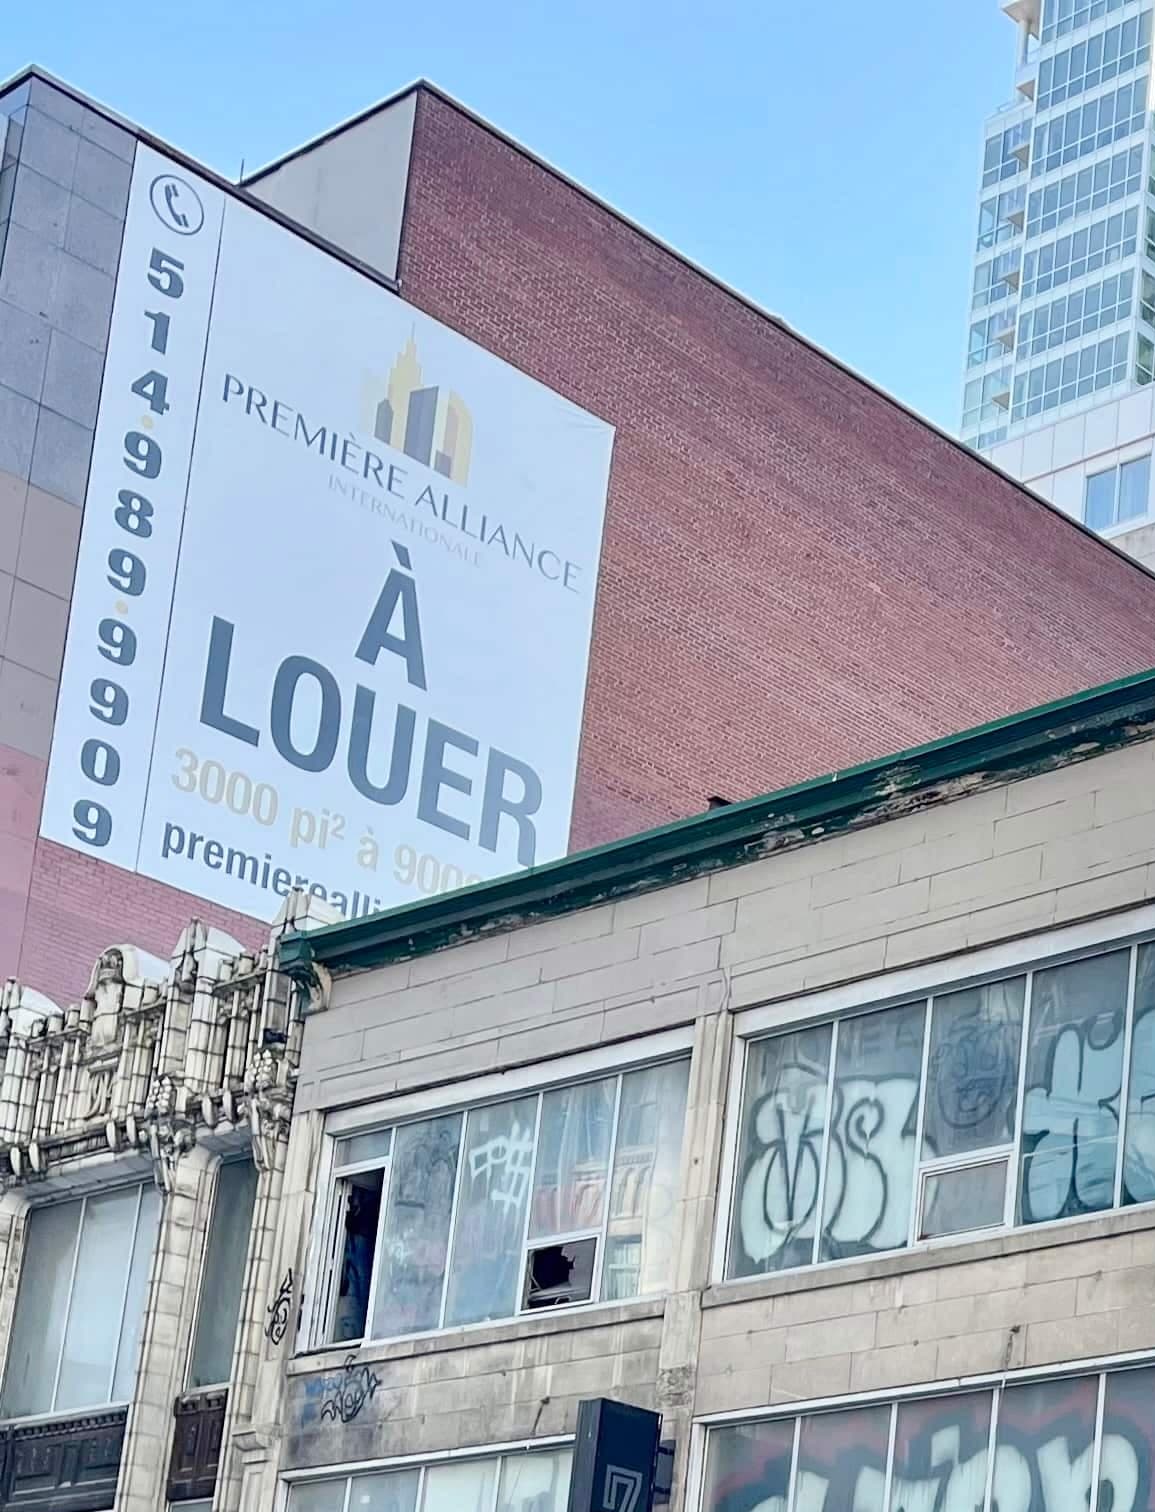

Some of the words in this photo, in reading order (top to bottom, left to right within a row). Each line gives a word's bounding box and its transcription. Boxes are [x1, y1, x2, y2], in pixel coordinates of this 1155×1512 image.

[222, 373, 408, 499] PREMIÈRE
[415, 484, 583, 594] ALLIANCE
[328, 472, 481, 568] INTERNATIONALE
[354, 539, 427, 691] À
[171, 746, 279, 827] 3000
[200, 615, 543, 867] LOUER
